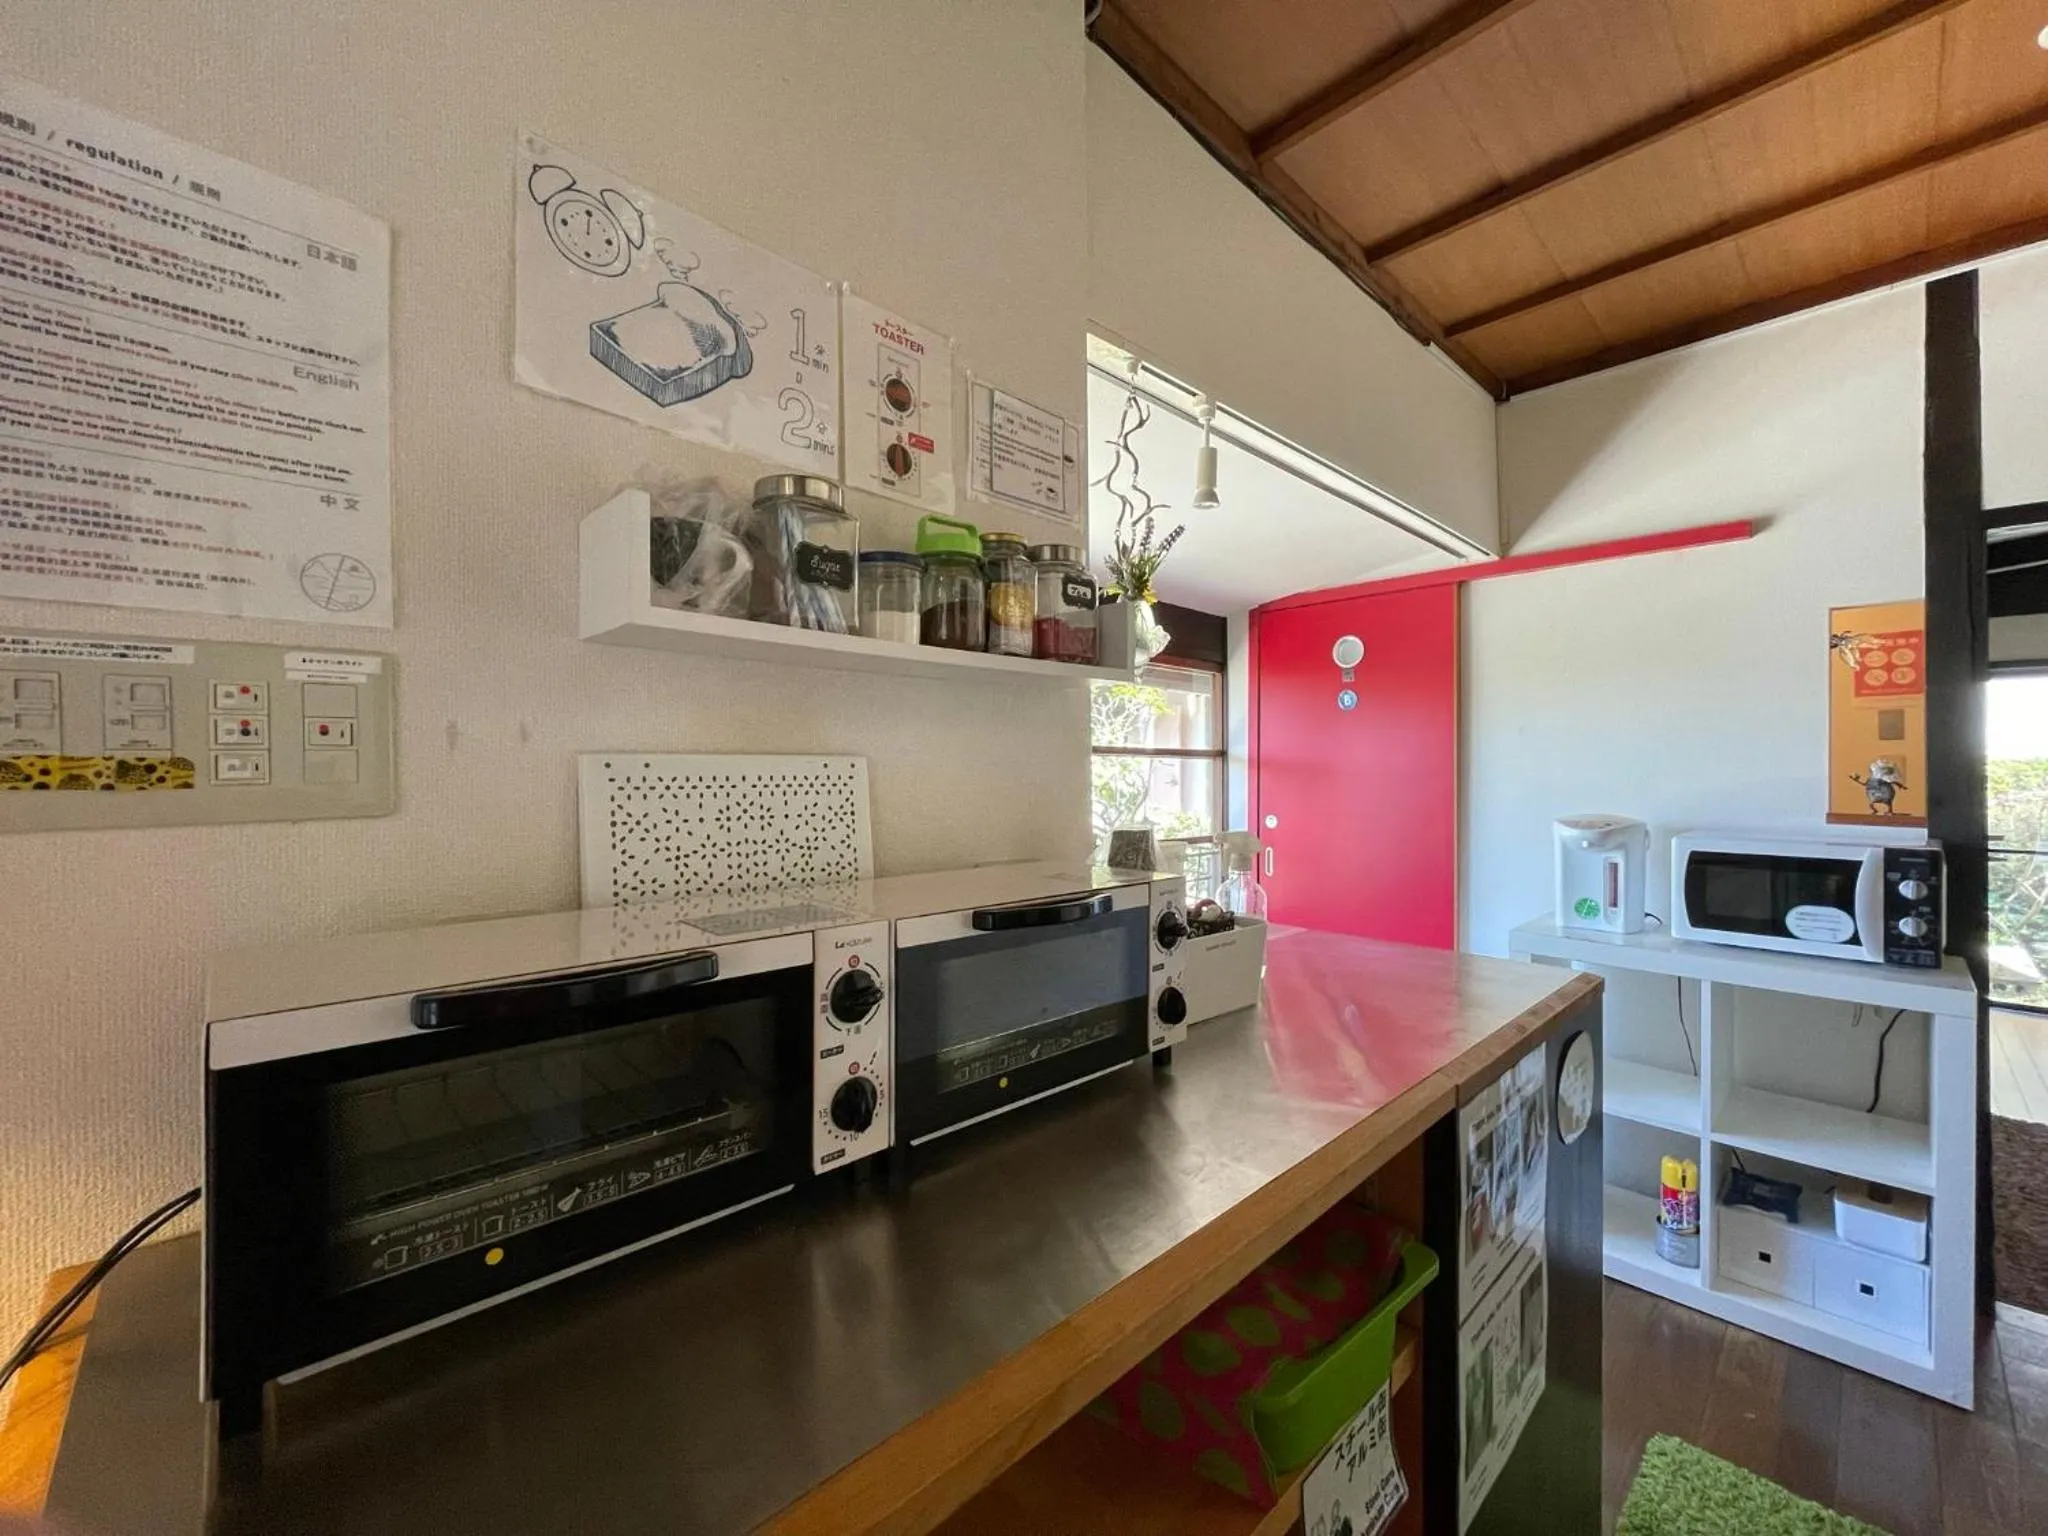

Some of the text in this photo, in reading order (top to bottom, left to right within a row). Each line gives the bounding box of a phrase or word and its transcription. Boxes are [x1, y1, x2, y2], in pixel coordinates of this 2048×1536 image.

[66, 140, 163, 180] regulation
[307, 245, 358, 271] 日本語
[2, 307, 28, 319] heck
[789, 308, 809, 365] 1
[873, 323, 925, 356] TOASTER
[293, 366, 360, 392] English
[777, 386, 815, 449] 2
[319, 494, 359, 511] 中文
[1335, 1390, 1386, 1471] スチール缶
[1346, 1417, 1388, 1484] アルミ缶
